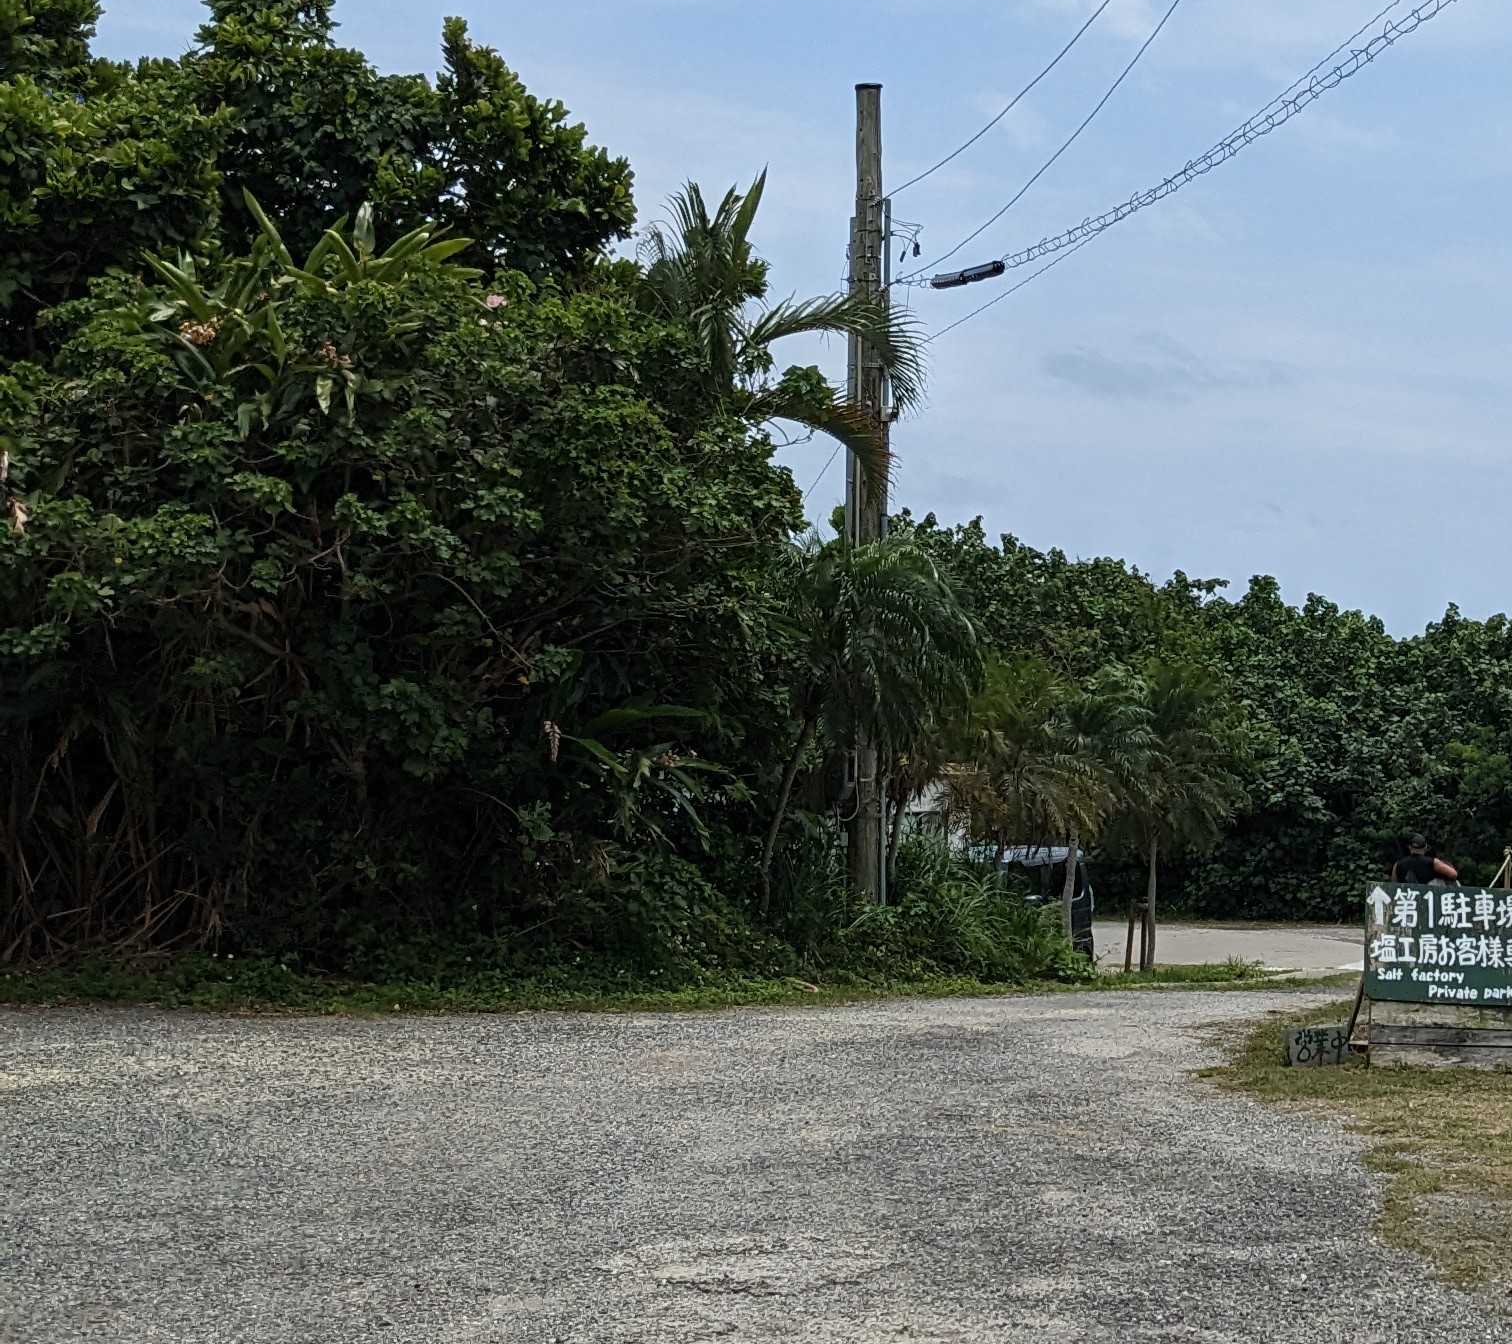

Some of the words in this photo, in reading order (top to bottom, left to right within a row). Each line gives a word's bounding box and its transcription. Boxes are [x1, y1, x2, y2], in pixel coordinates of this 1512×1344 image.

[1377, 968, 1404, 981] Salt
[1410, 968, 1465, 984] factory
[1428, 984, 1478, 1000] Private
